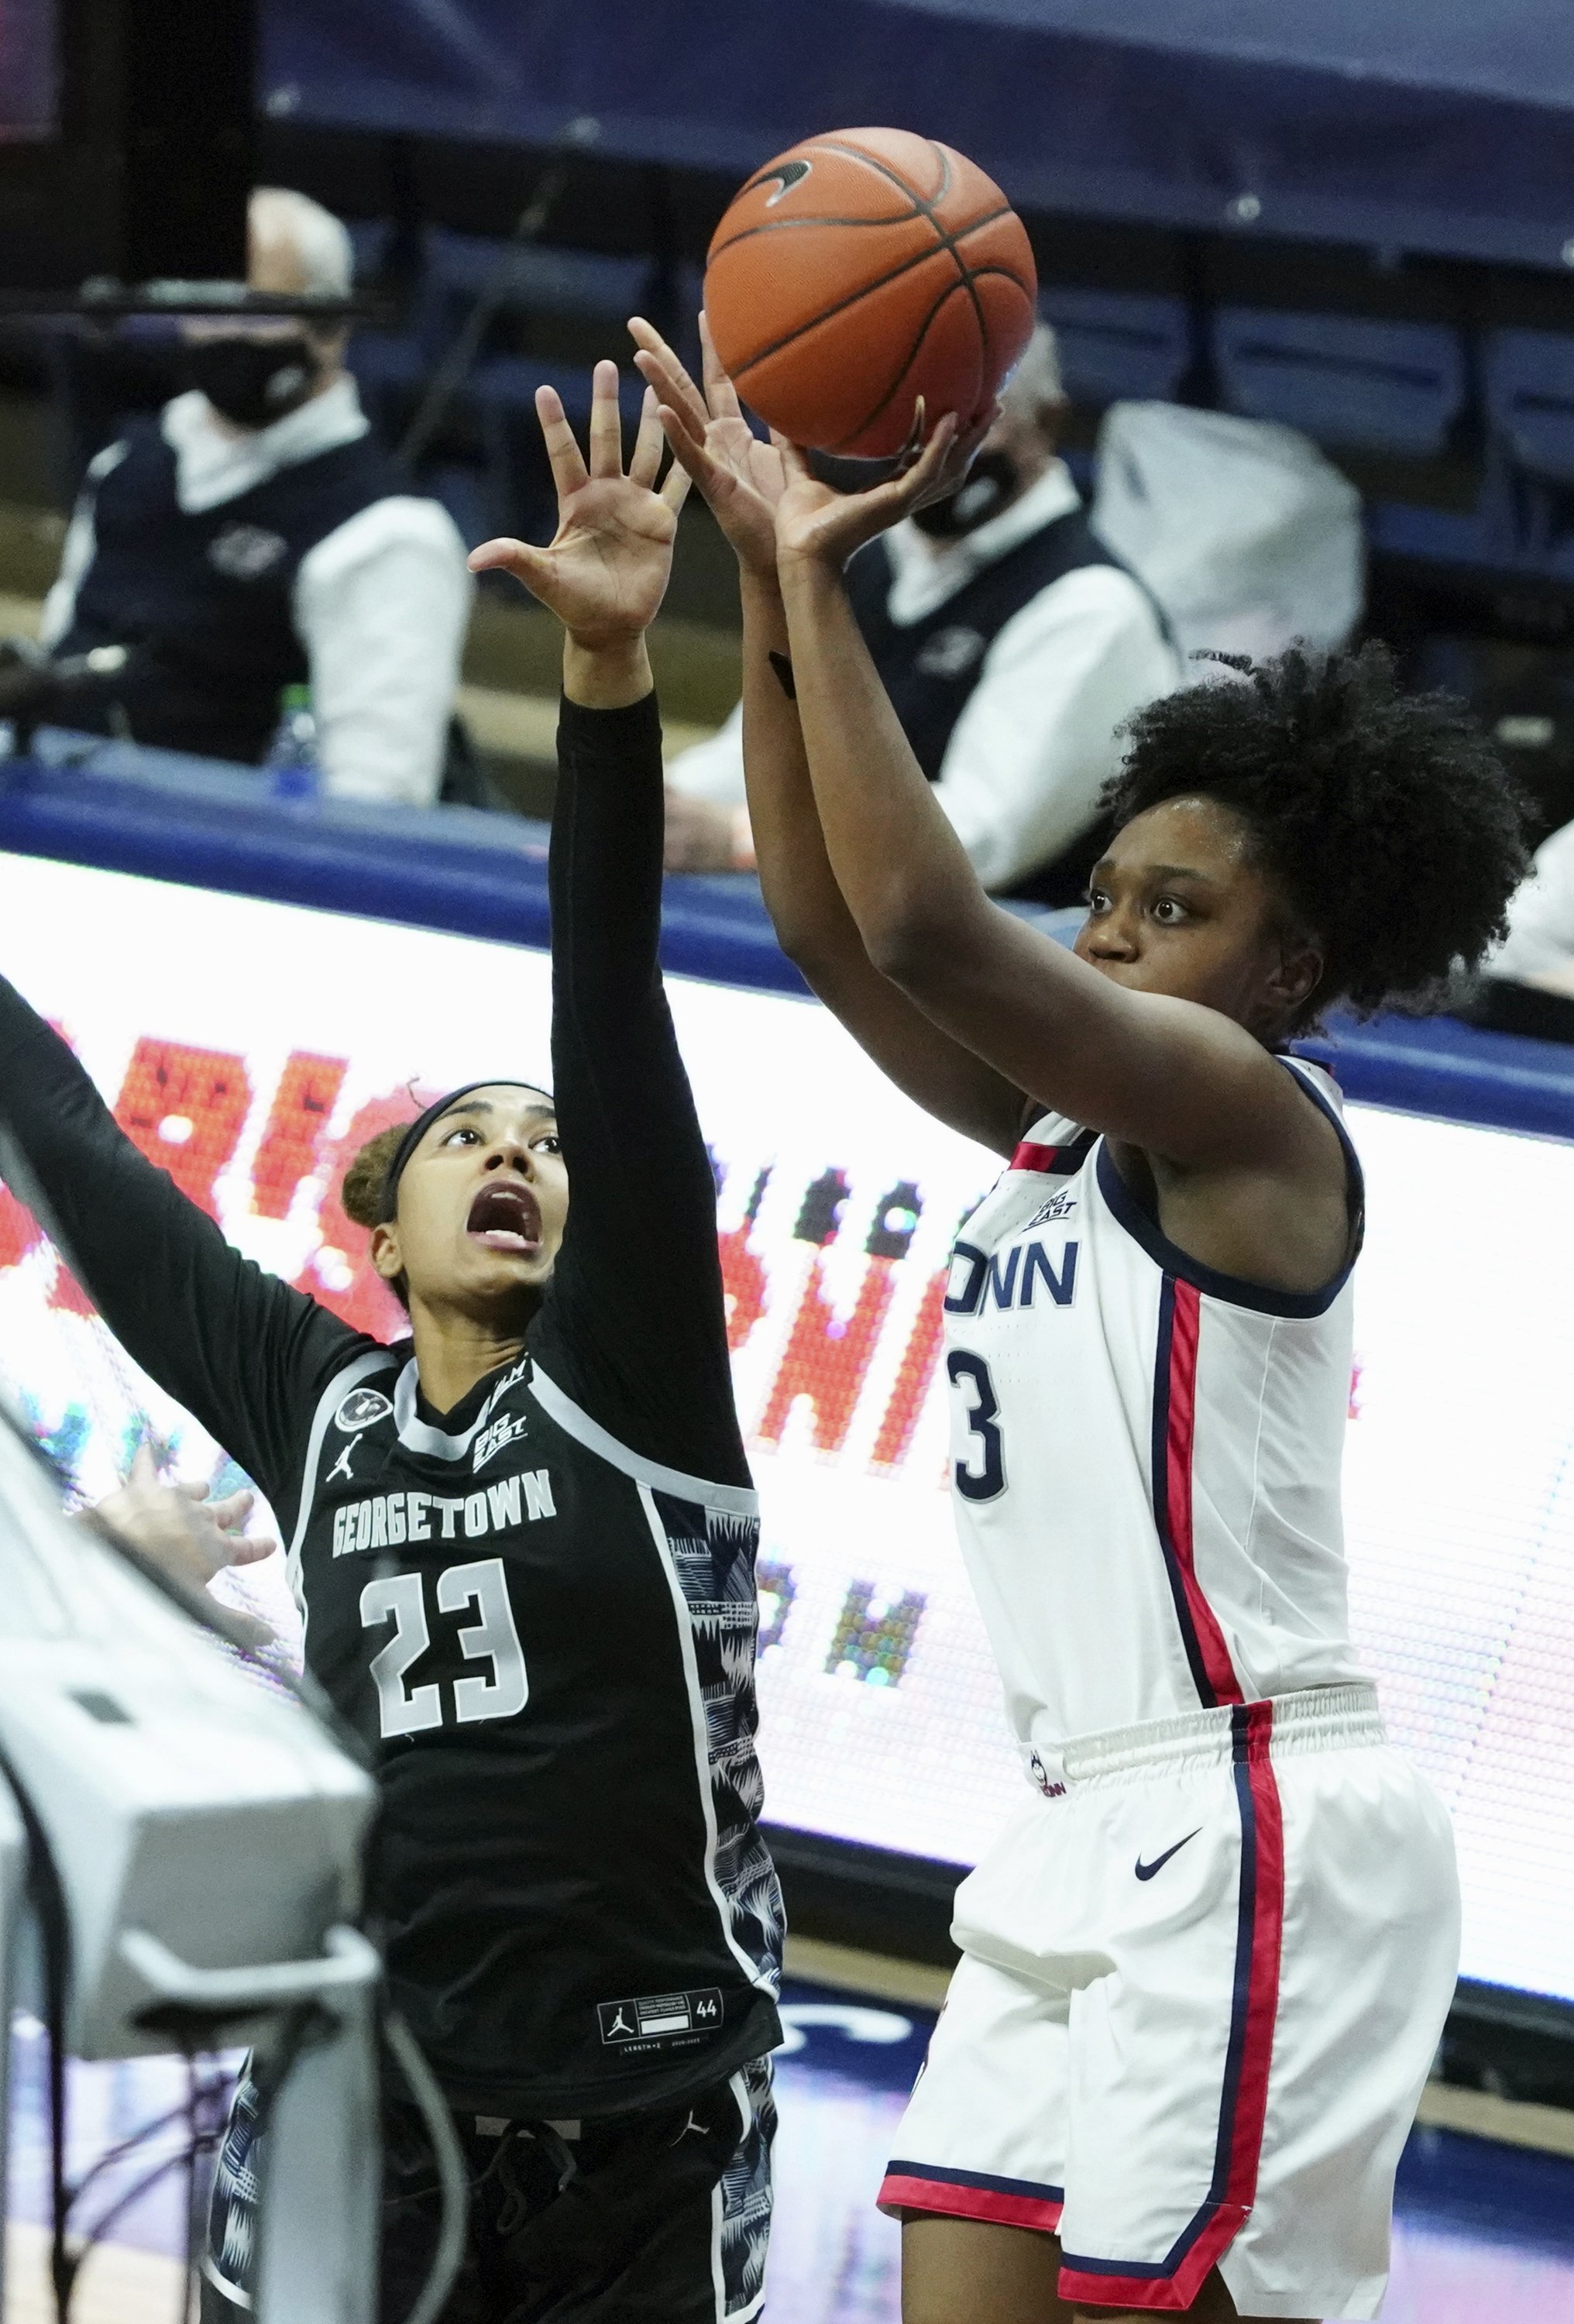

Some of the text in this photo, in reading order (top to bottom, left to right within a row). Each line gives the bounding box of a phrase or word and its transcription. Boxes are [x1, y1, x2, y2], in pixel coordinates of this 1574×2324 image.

[1028, 1201, 1078, 1227] EAST
[473, 1412, 511, 1454] BIG
[473, 1415, 528, 1470] EAST
[947, 1346, 1009, 1504] 3
[332, 1468, 557, 1559] GEORGETOWN
[359, 1557, 530, 1738] 23
[696, 1999, 717, 2018] 44
